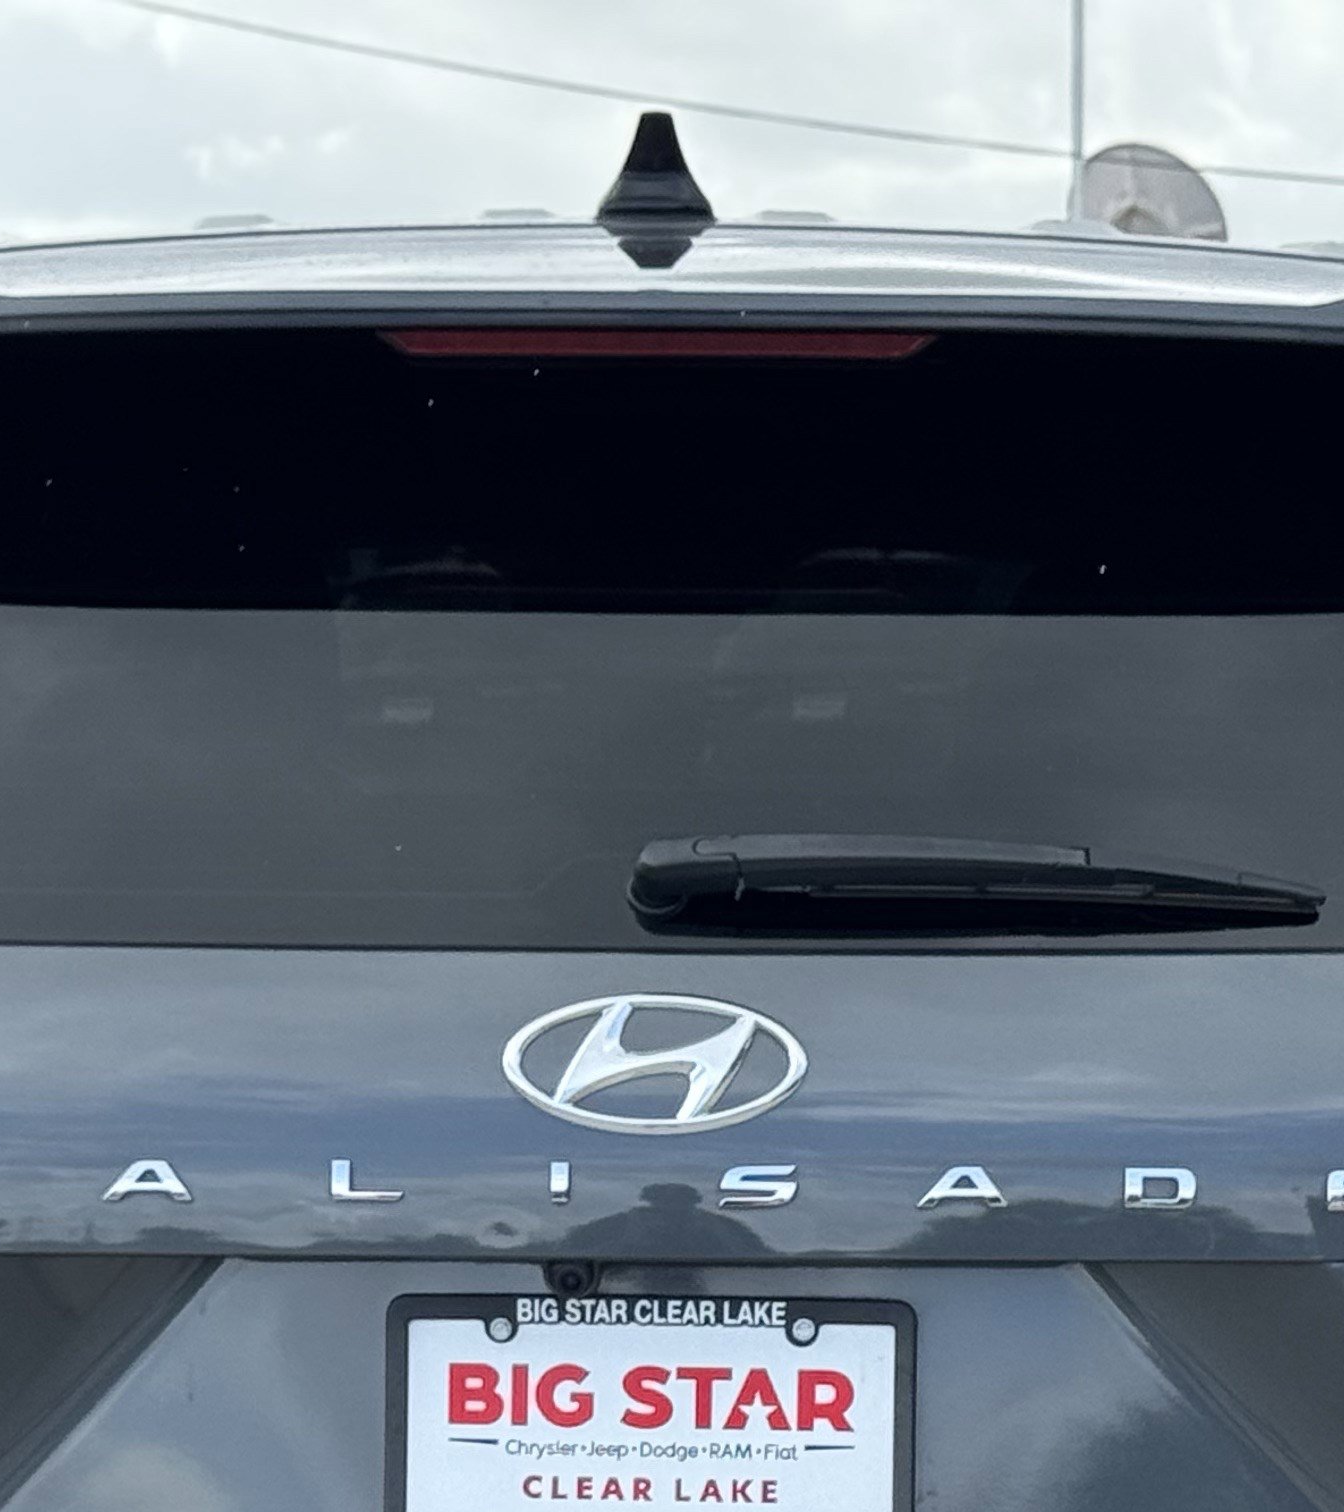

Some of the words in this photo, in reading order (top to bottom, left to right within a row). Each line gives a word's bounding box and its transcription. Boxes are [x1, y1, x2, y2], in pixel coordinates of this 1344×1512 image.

[516, 1299, 558, 1324] BIG
[564, 1299, 628, 1325] STAR
[634, 1300, 716, 1326] CLEAR
[722, 1301, 787, 1327] LAKE
[448, 1362, 595, 1428] BIG
[620, 1365, 855, 1432] STAR
[522, 1474, 653, 1502] CLEAR
[674, 1478, 779, 1505] LAKE
